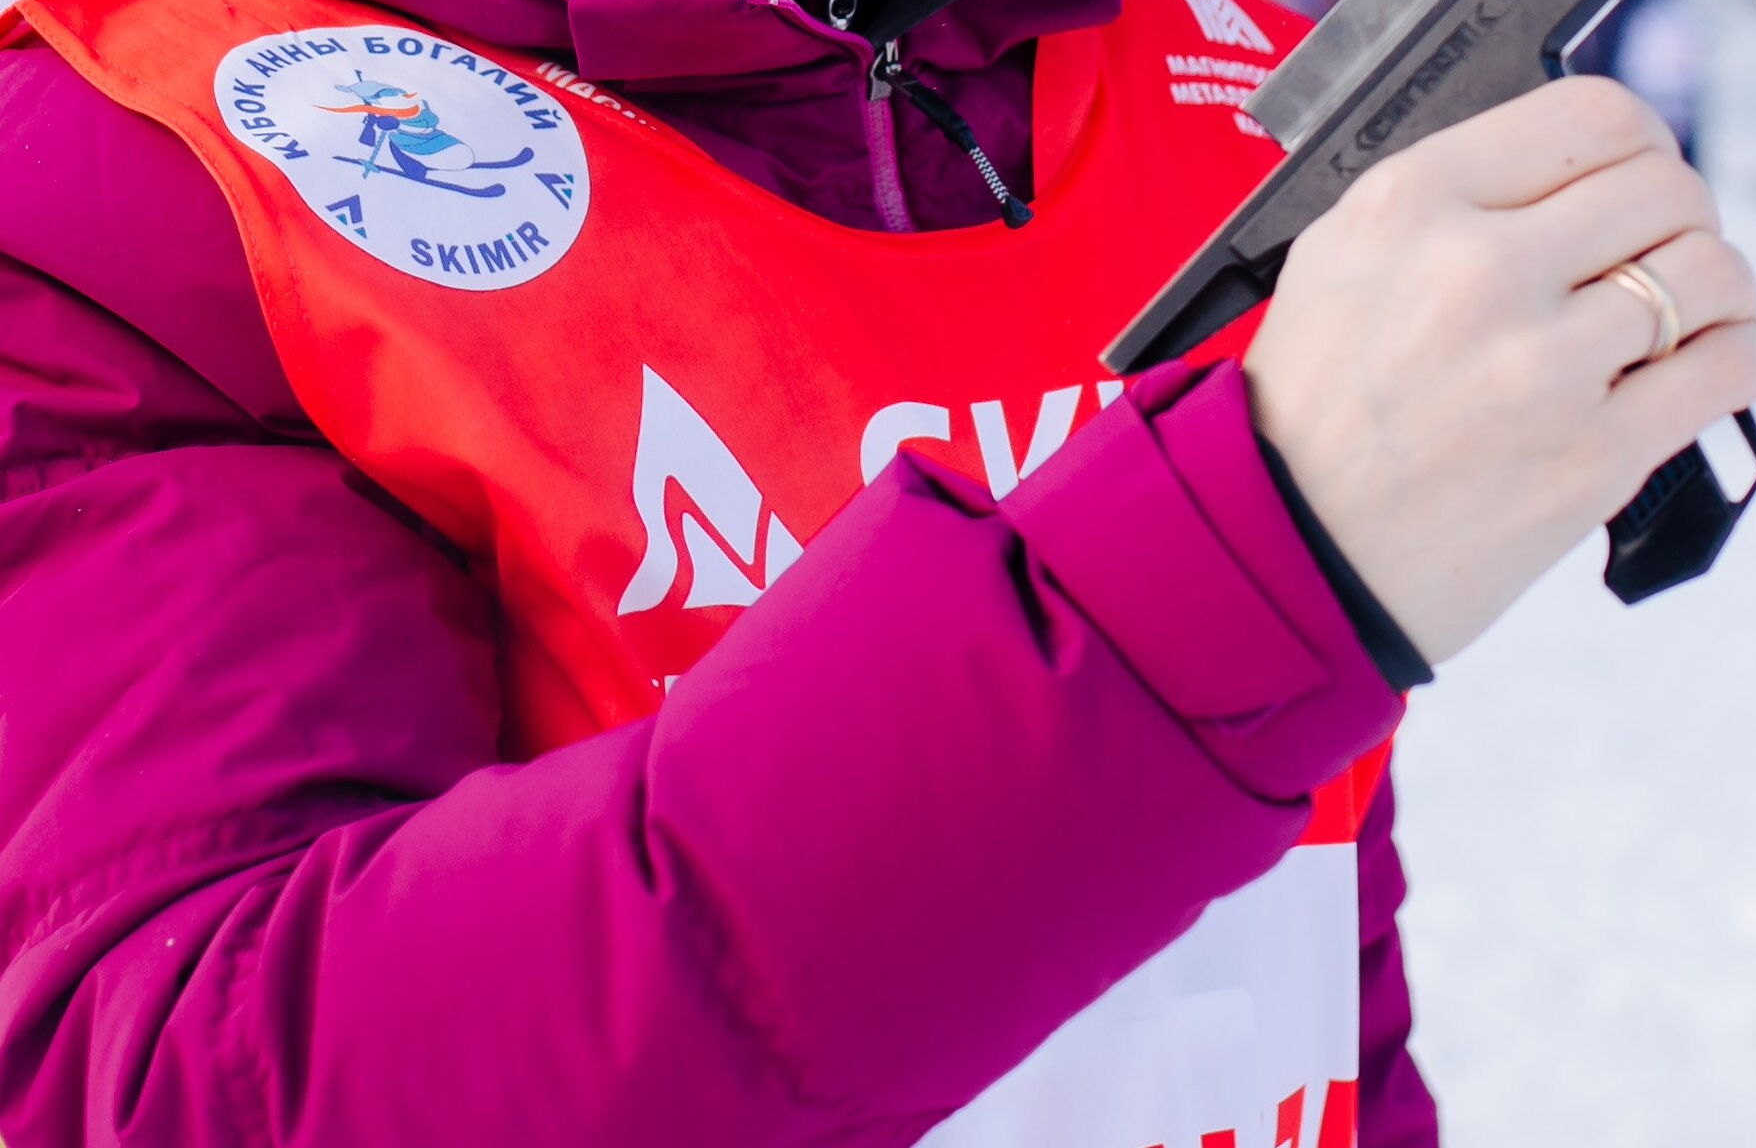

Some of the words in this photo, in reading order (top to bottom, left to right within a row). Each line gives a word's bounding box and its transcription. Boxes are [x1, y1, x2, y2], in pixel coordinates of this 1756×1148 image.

[244, 36, 349, 79] АННЫ
[362, 36, 563, 131] БОГАЛИЙ
[232, 77, 310, 161] КУБОК
